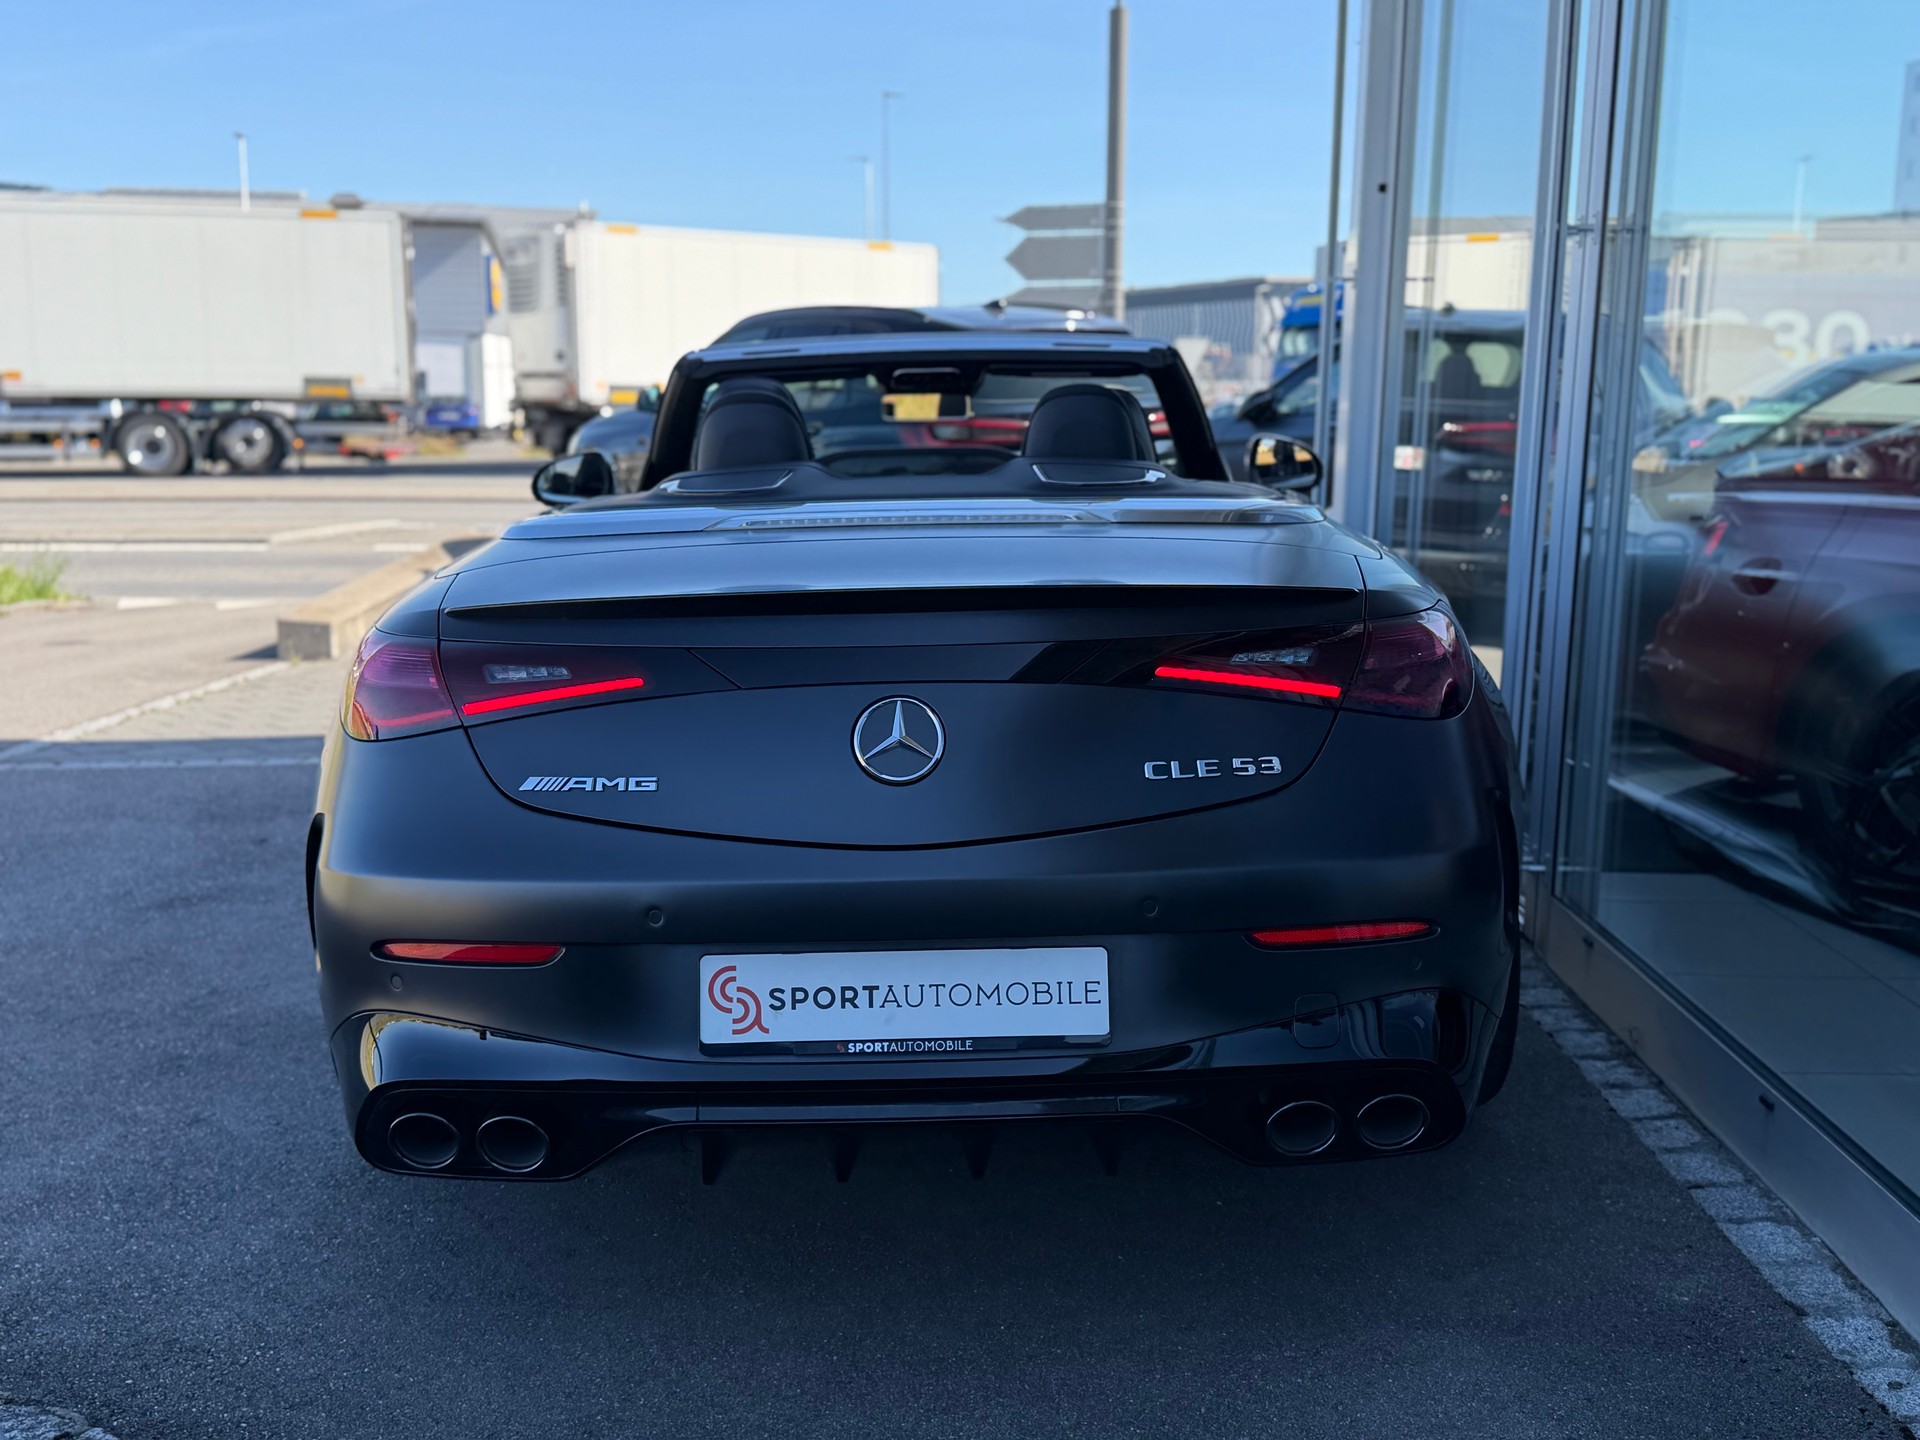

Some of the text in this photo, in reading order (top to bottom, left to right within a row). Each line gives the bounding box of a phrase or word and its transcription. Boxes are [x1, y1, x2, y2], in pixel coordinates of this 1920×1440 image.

[1144, 756, 1282, 780] CLE 53
[562, 776, 659, 792] AMG
[768, 980, 1102, 1012] SPORTAUTOMOBILE
[847, 1039, 973, 1053] SPORTAUTOMOBILE
